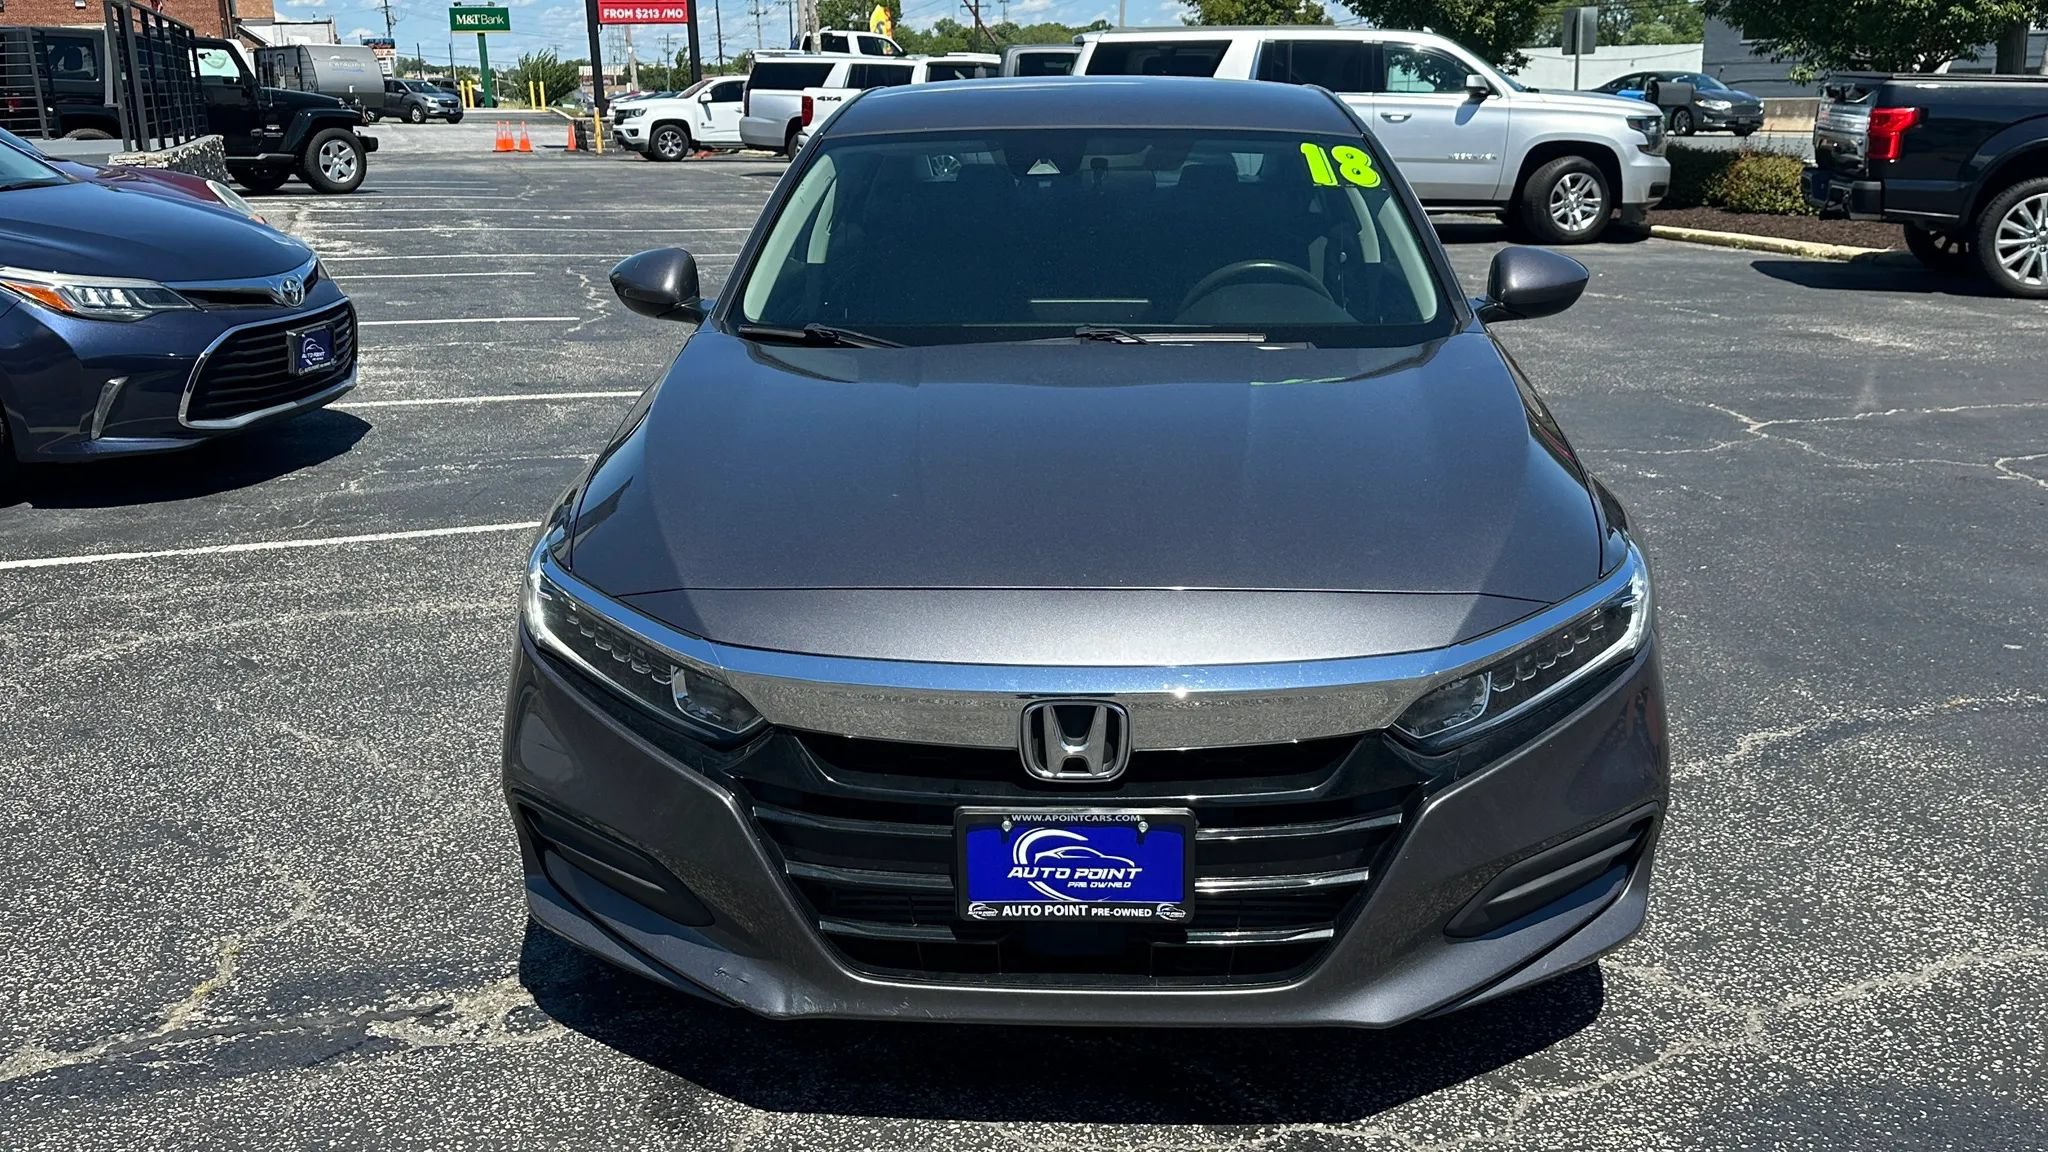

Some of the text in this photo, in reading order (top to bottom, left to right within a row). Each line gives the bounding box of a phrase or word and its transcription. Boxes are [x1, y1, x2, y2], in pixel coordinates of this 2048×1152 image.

[480, 14, 505, 25] Bank
[603, 8, 684, 20] FROM $213 /MO
[1300, 142, 1381, 188] 18
[1011, 814, 1141, 823] WWW.APOINTCARS.COM
[1007, 866, 1143, 880] AUTO POINT
[1067, 881, 1132, 889] PRE OWNED
[1002, 904, 1153, 917] AUTO POINT PRE-OWNED
